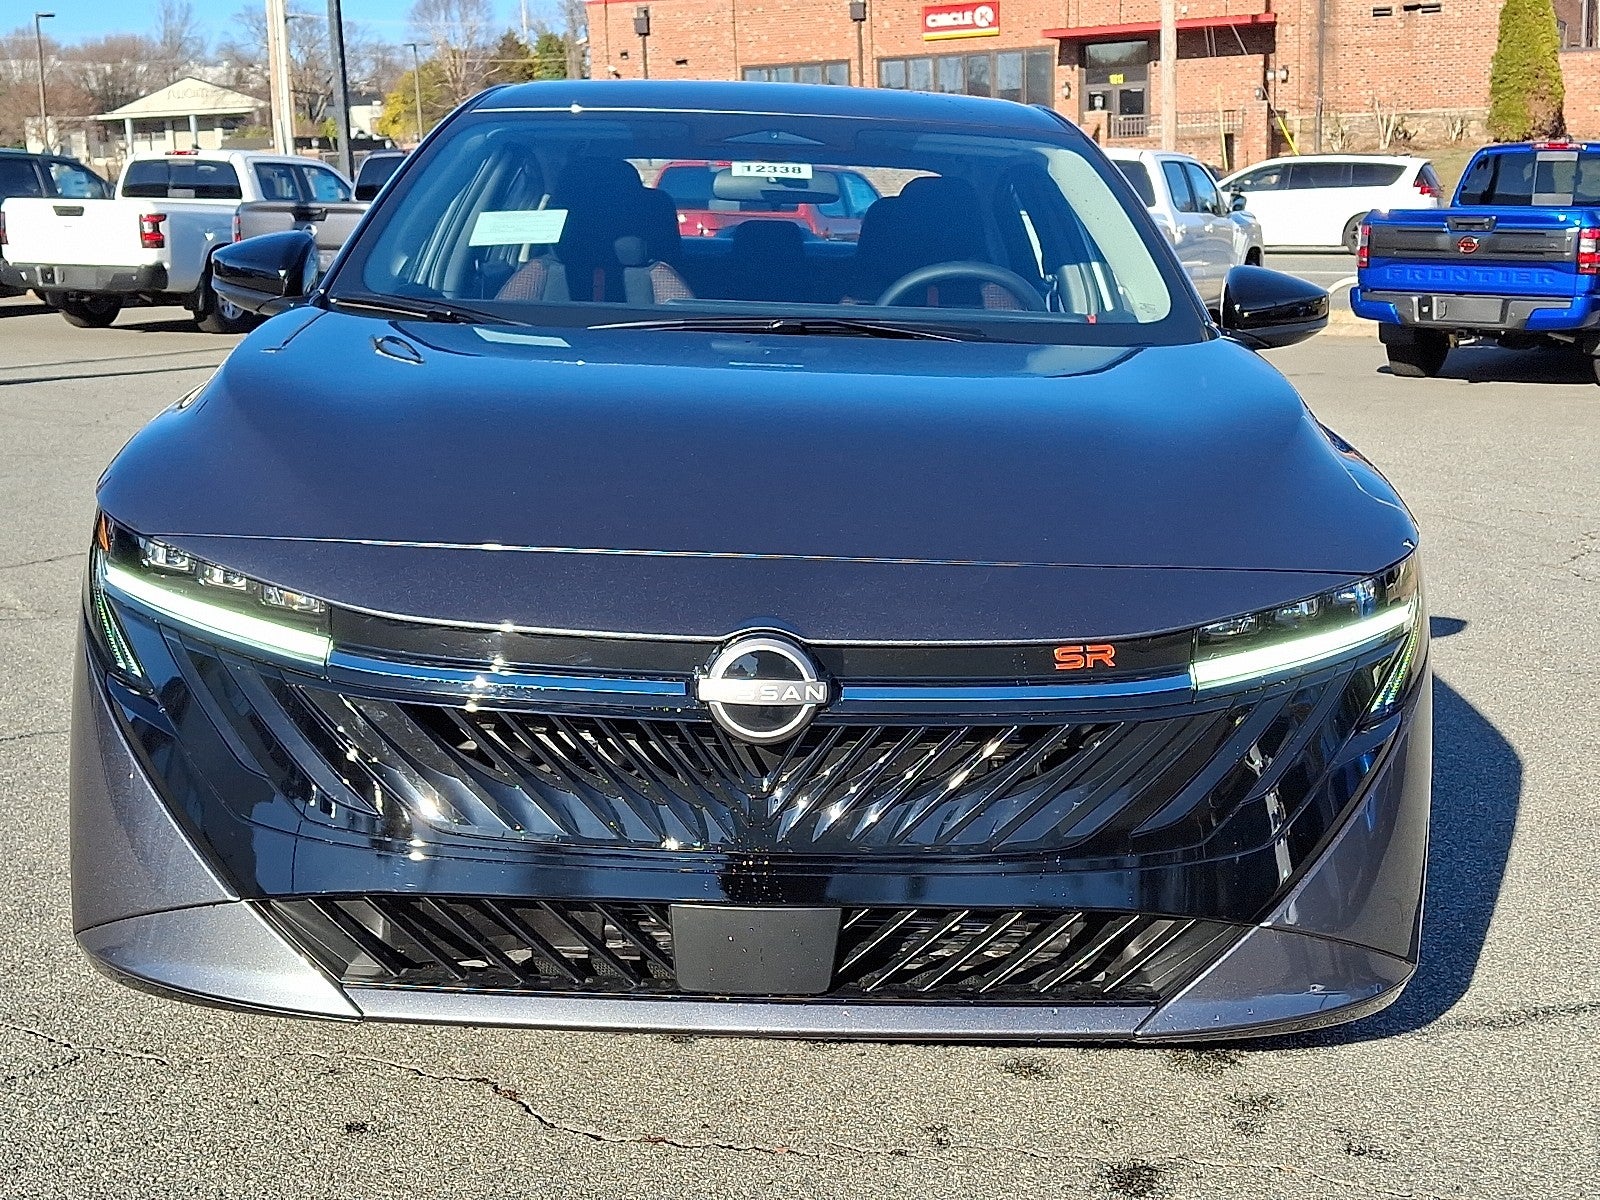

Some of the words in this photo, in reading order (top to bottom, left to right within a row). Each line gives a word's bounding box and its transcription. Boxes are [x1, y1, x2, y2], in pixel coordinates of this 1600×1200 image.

[925, 11, 973, 28] CIRCLE
[742, 164, 802, 174] 12338
[1386, 268, 1554, 284] FRONTIER
[1053, 644, 1116, 669] SR
